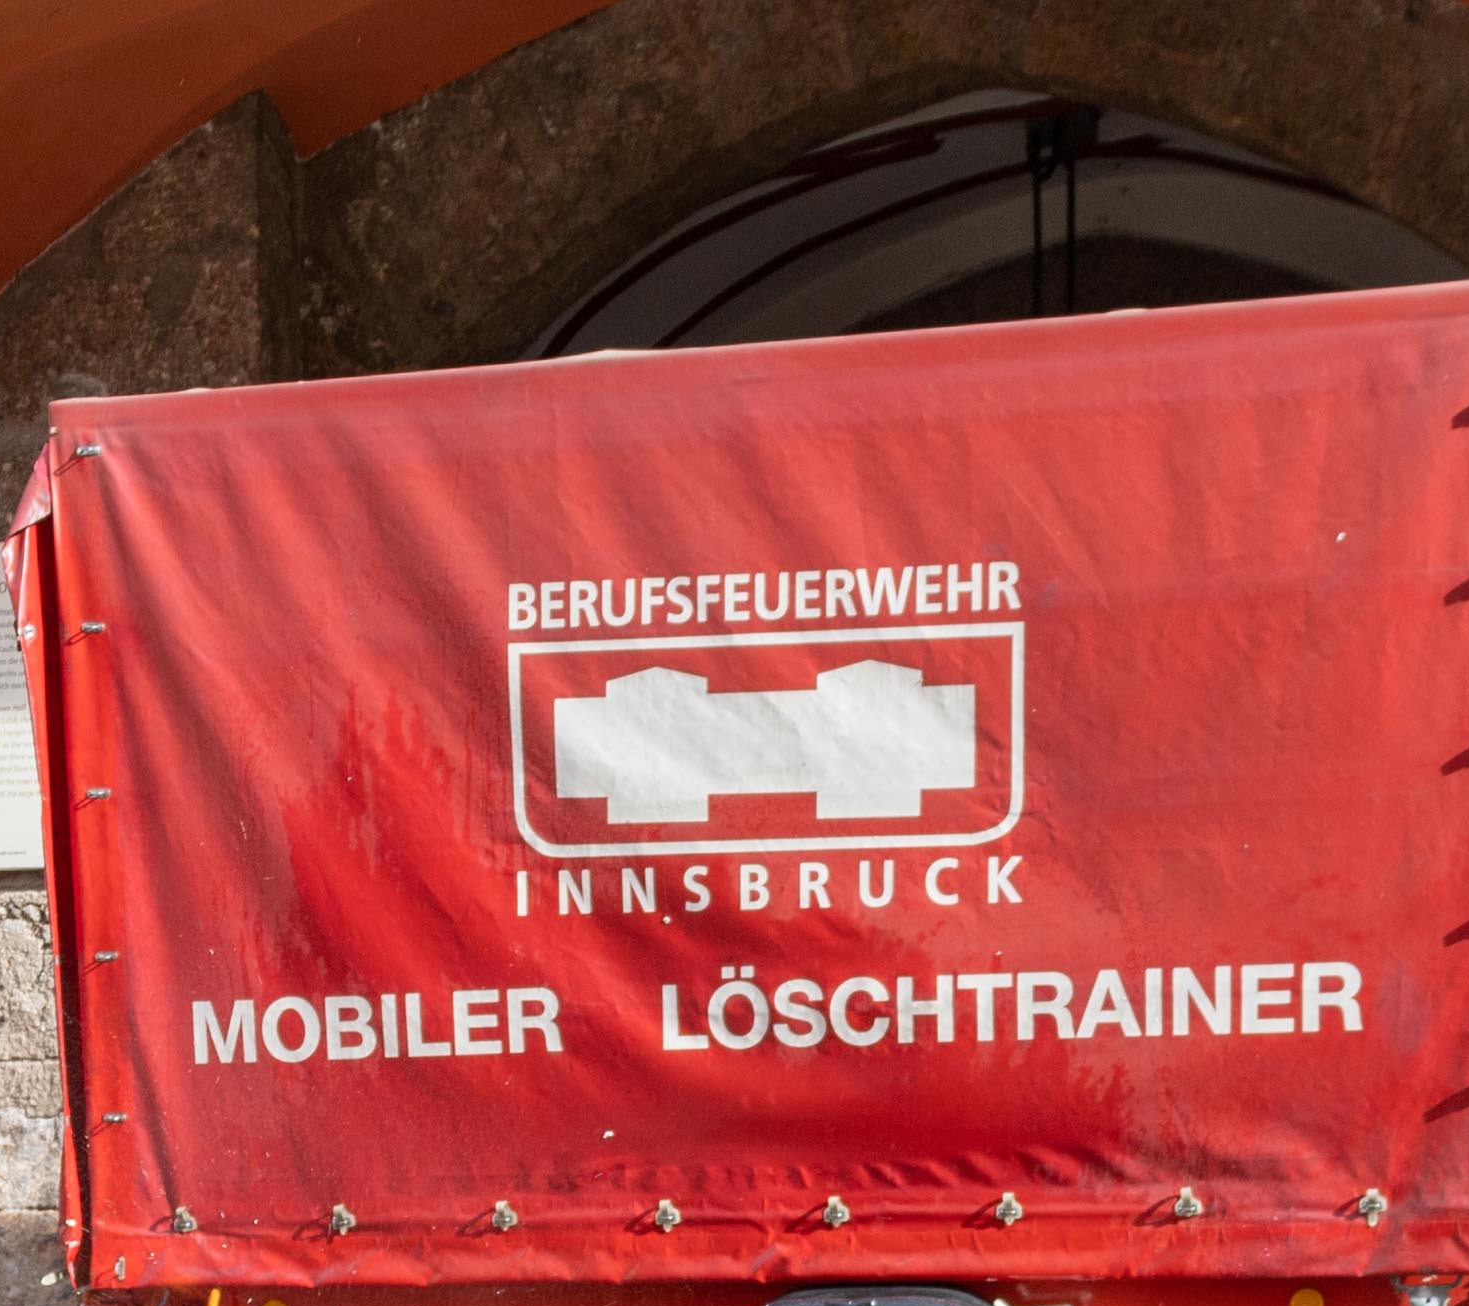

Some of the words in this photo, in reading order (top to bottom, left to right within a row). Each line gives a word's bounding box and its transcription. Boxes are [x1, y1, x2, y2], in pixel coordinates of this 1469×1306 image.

[508, 561, 1021, 632] BERUFSFEUERWEHR
[515, 856, 1024, 917] INNSBRUCK
[192, 987, 564, 1065] MOBILER
[662, 961, 1364, 1052] LÖSCHTRAINER
